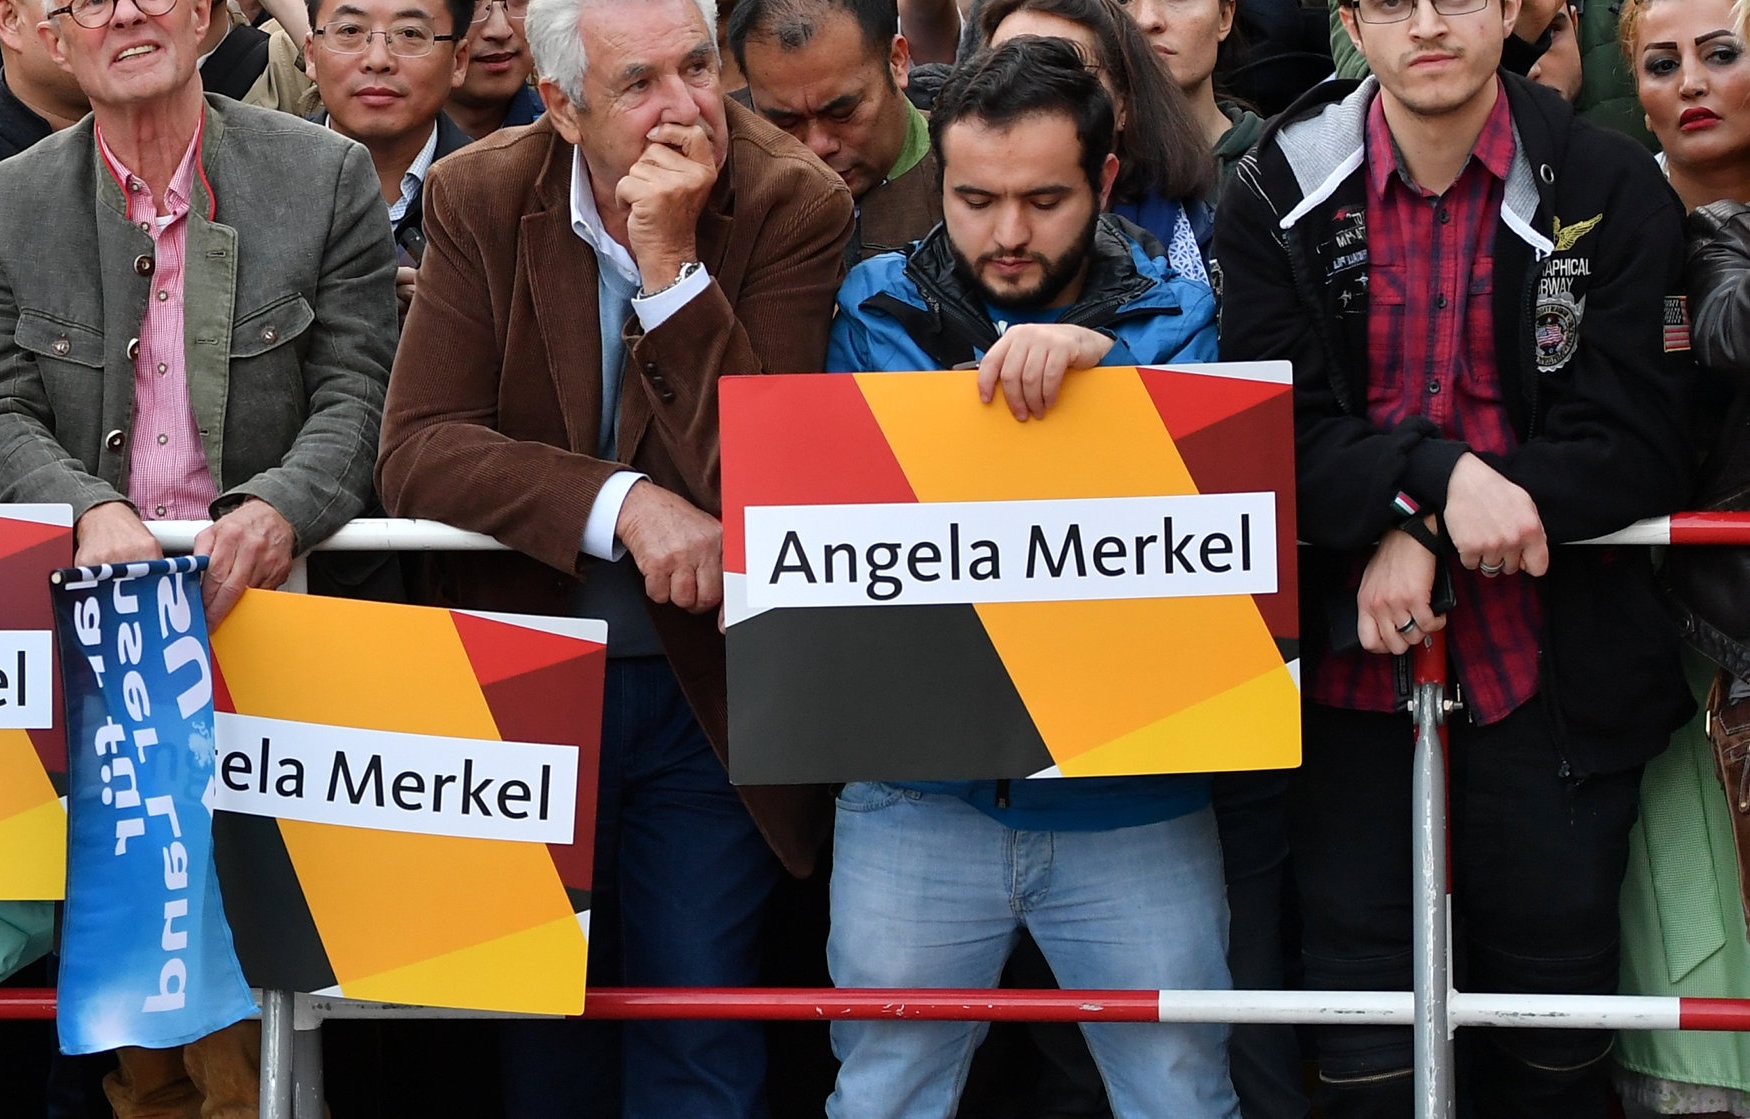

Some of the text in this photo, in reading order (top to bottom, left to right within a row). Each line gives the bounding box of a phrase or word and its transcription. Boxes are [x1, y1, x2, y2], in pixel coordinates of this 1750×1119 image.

[769, 513, 1251, 601] Angela Merkel
[214, 737, 551, 821] ela Merkel
